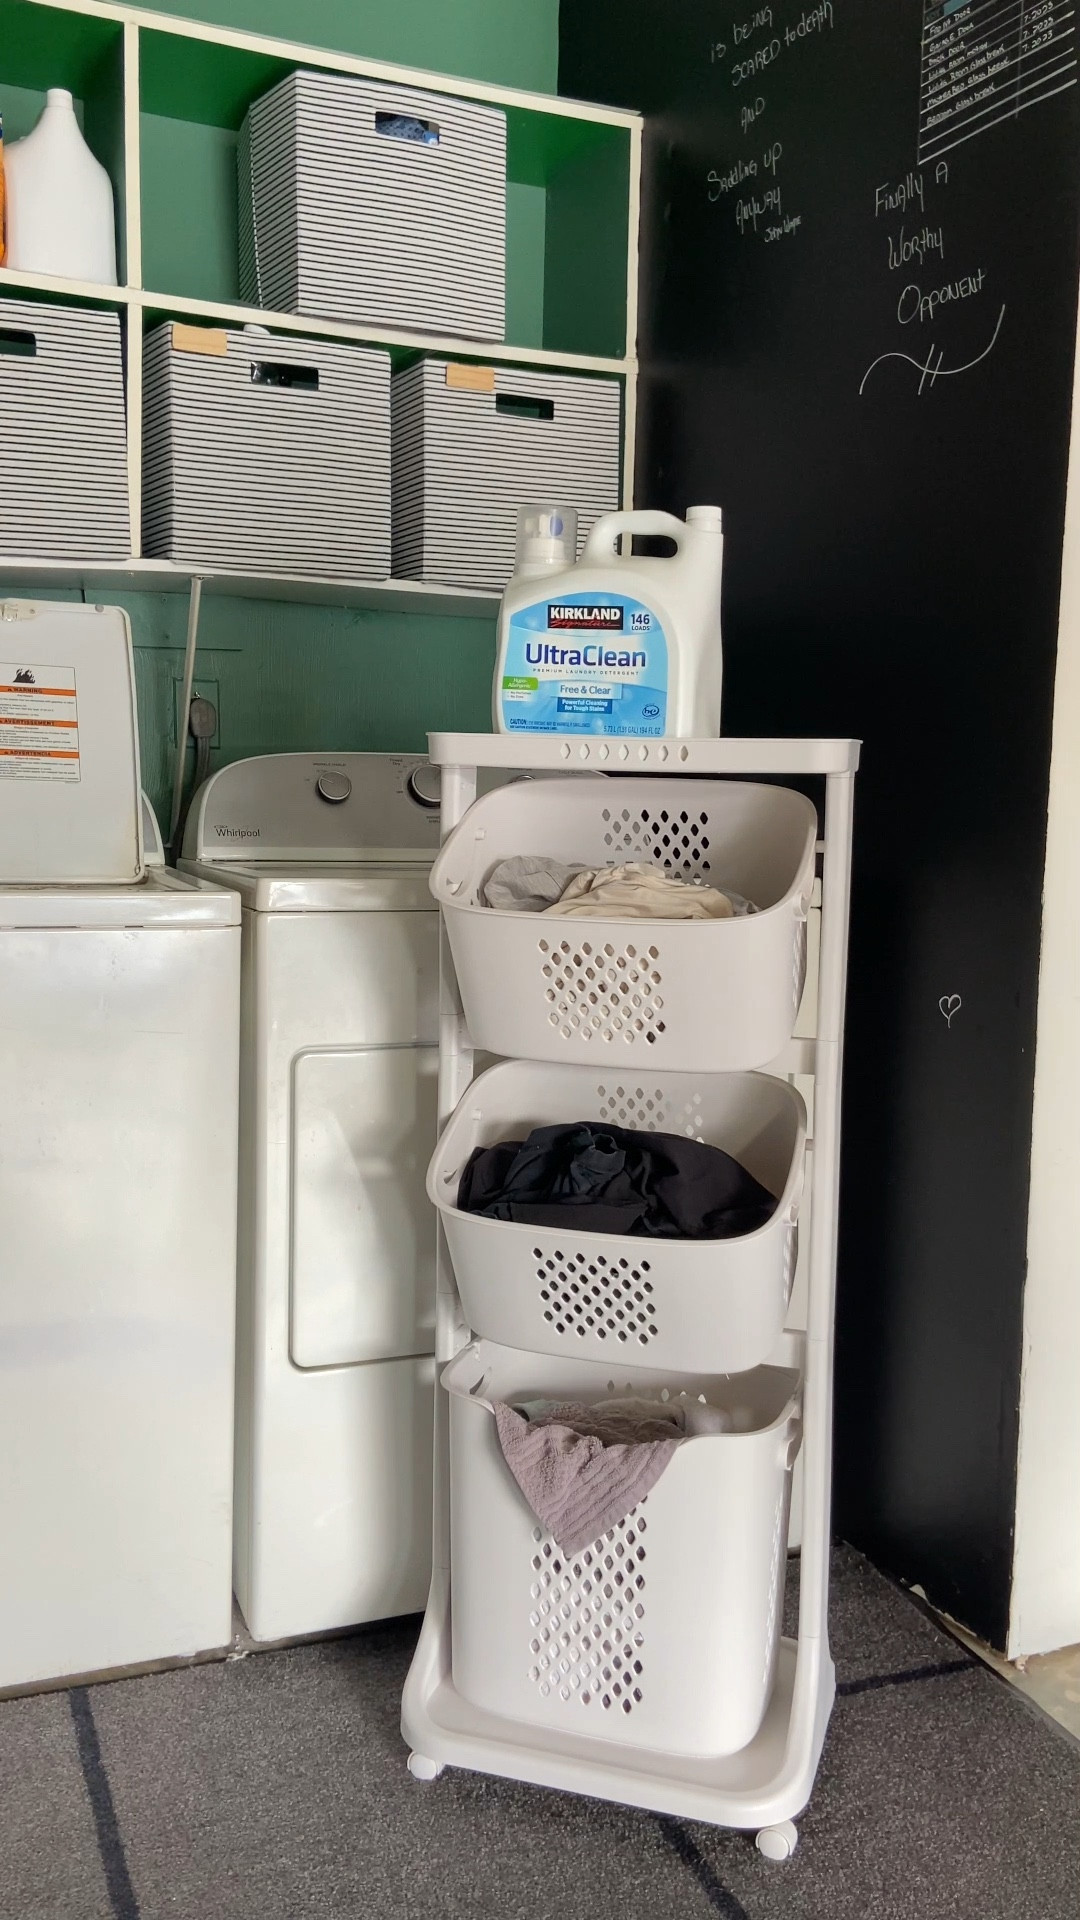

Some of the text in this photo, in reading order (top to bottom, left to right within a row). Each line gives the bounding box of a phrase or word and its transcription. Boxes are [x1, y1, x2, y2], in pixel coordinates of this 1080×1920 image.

[710, 43, 727, 63] is
[731, 39, 781, 87] SCARED
[784, 26, 796, 47] to
[741, 97, 765, 134] AND
[935, 161, 949, 184] A
[550, 607, 621, 620] KIRKLAND
[631, 614, 650, 625] 146
[550, 619, 620, 628] Signature
[526, 643, 646, 667] UltraClean
[560, 684, 611, 695] Free & Clear
[215, 828, 261, 839] Whirlpool
